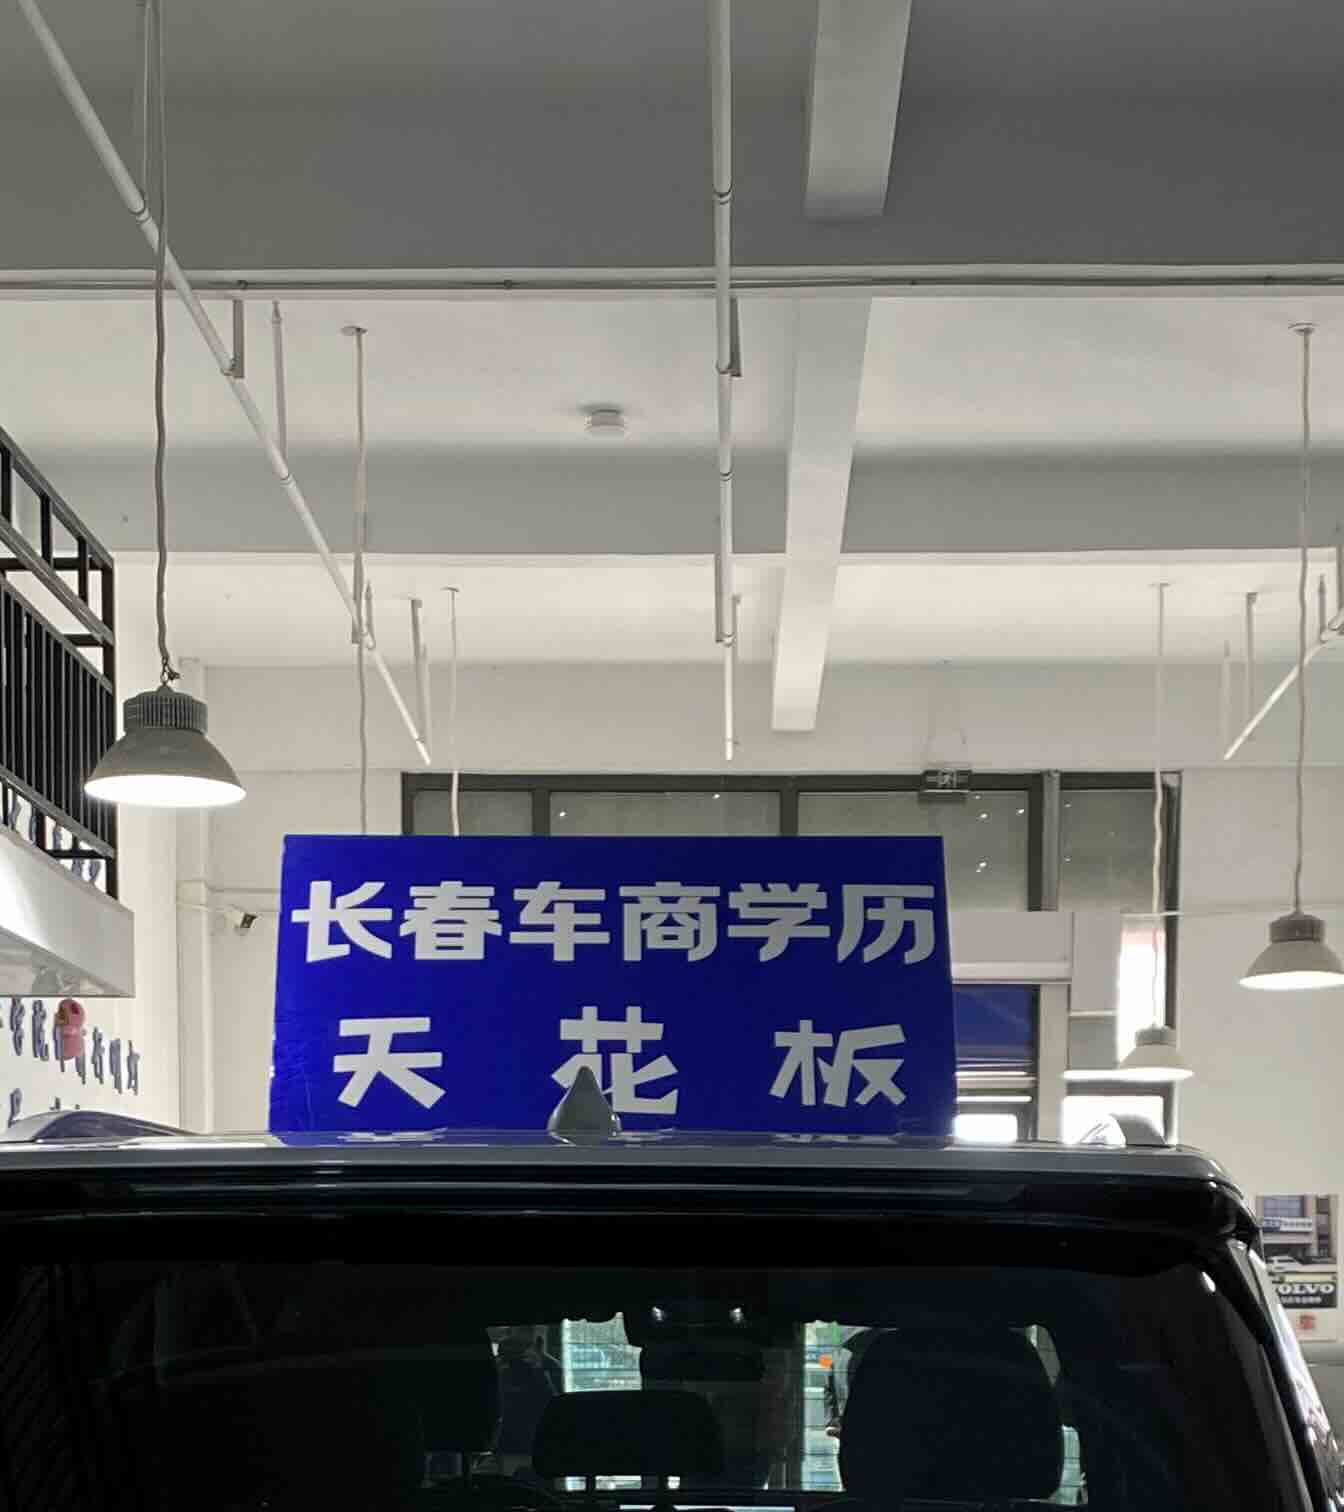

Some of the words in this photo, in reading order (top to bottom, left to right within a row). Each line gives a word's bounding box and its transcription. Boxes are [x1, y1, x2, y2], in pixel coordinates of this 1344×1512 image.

[291, 880, 937, 963] 长春车商学历
[333, 1006, 906, 1115] 天花板
